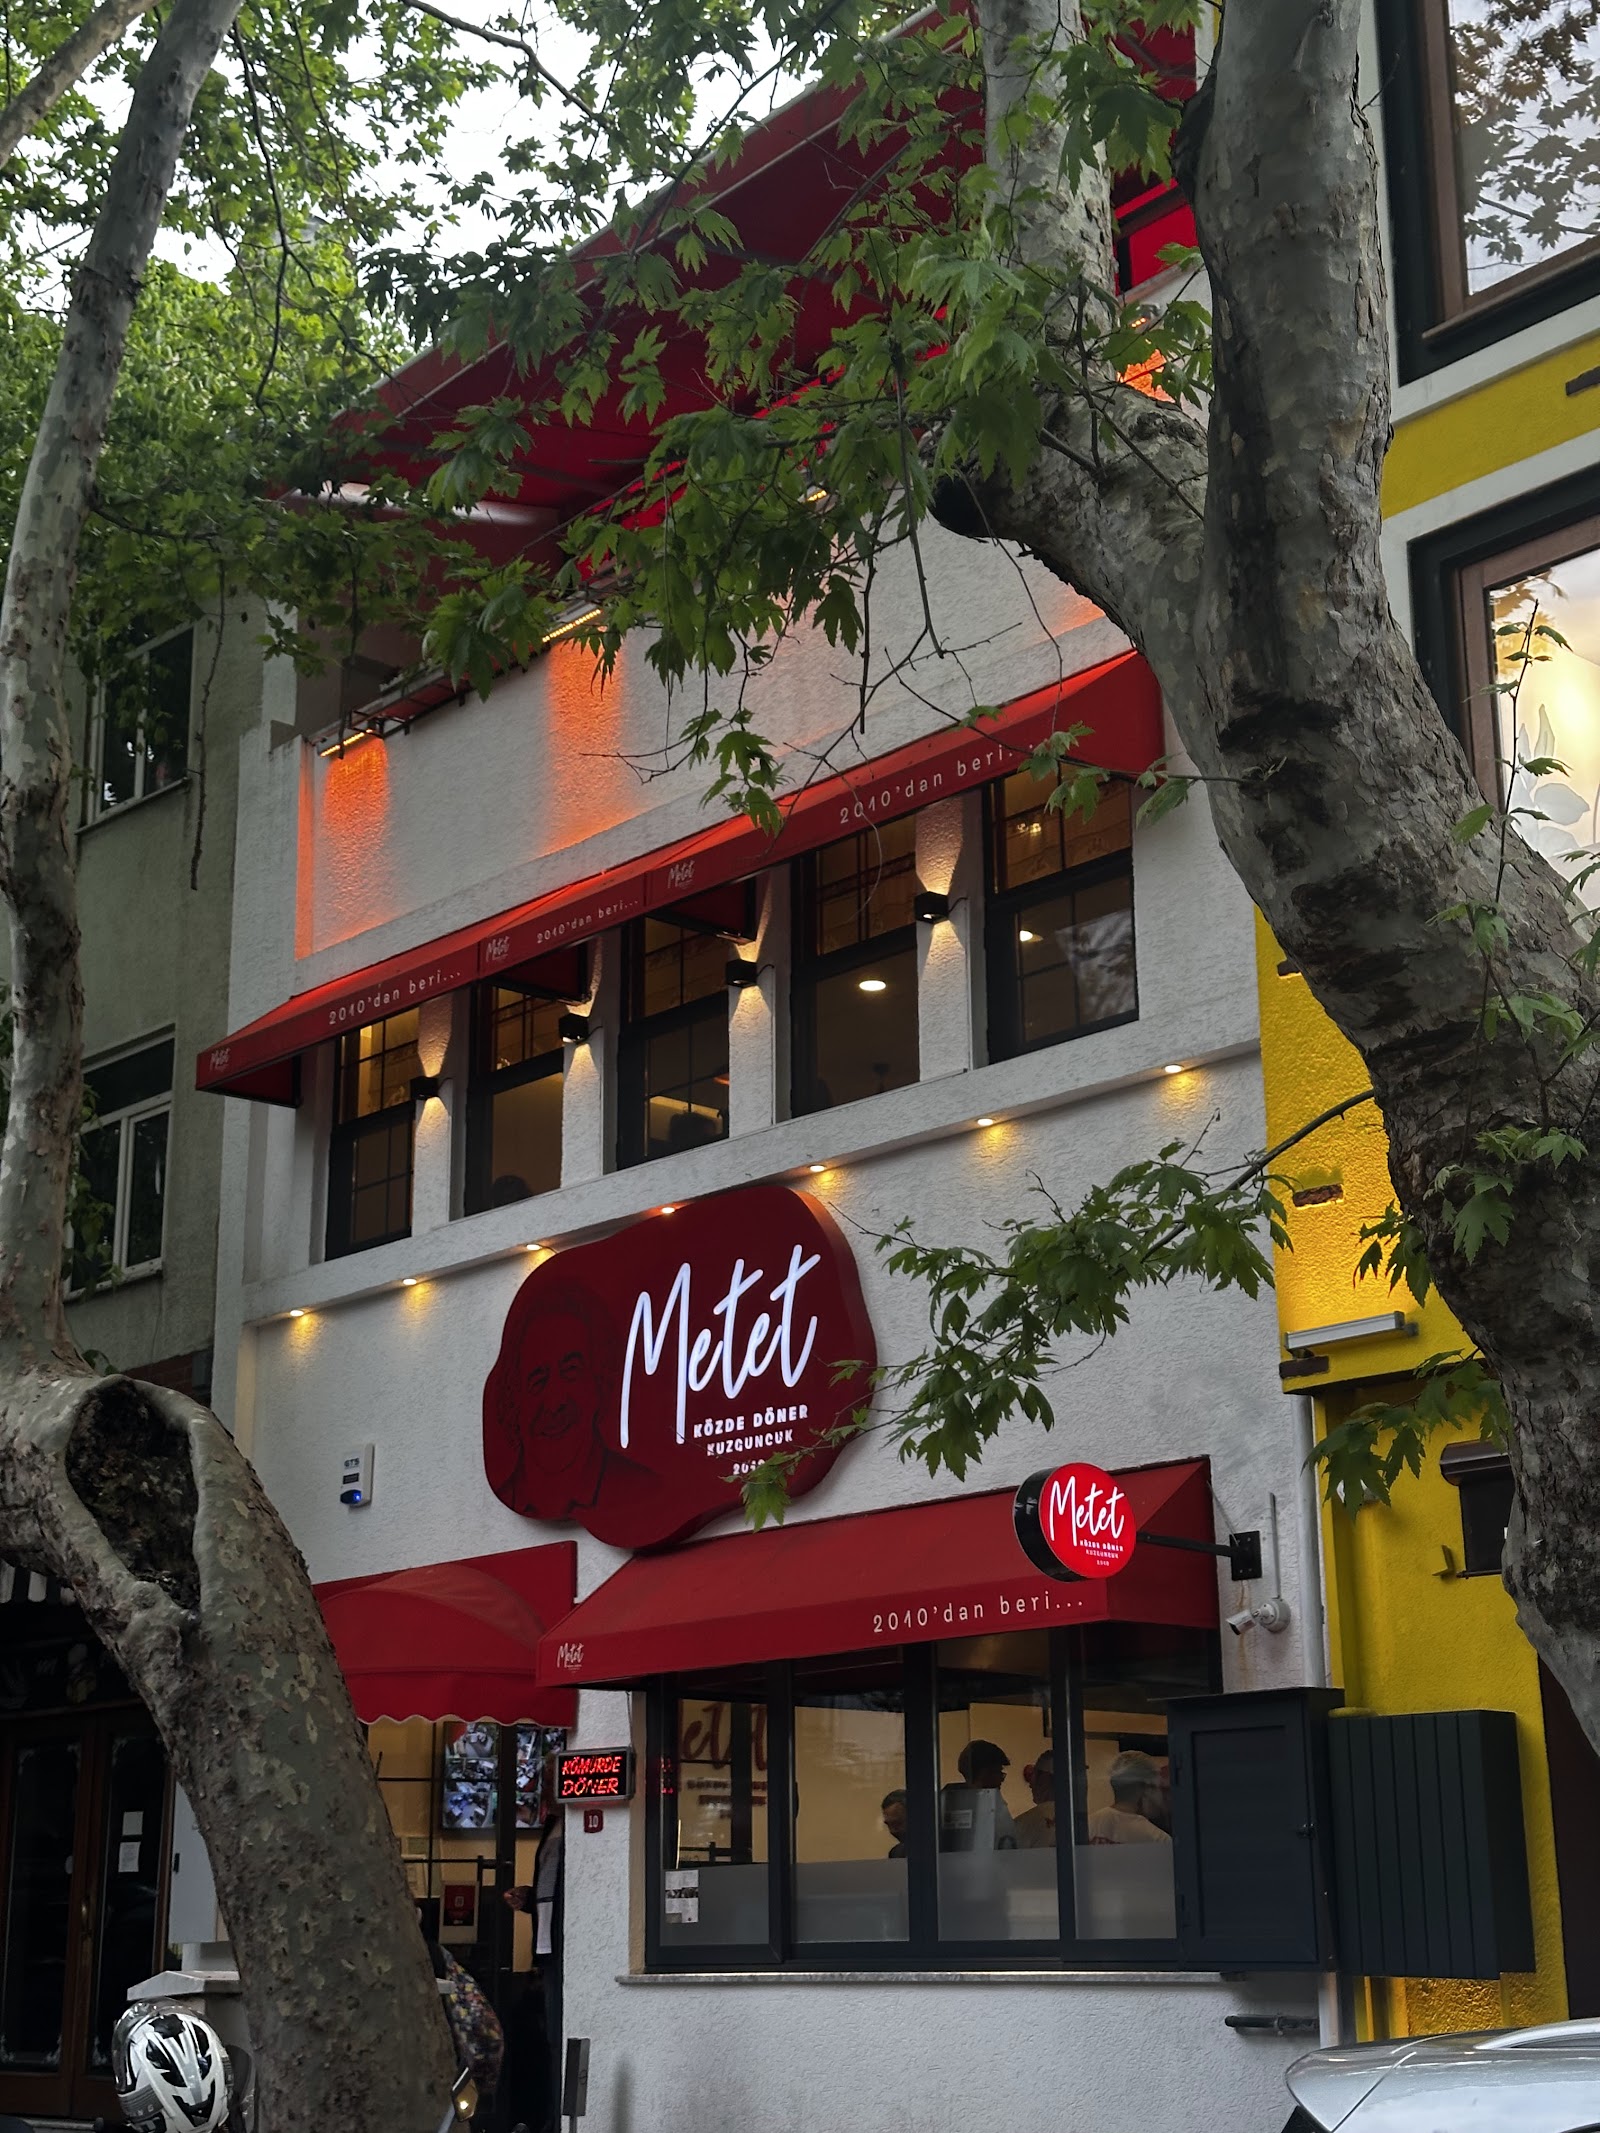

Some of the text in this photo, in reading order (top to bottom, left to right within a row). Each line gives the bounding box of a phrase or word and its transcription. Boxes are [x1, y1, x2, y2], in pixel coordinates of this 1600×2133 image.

[409, 969, 461, 994] beri...
[620, 1244, 821, 1449] Metet
[693, 1404, 808, 1439] KÖZDE DÖNER
[1049, 1476, 1125, 1547] Metet
[873, 1591, 1083, 1633] 2010'dan beri...
[562, 1777, 619, 1796] DÖNER
[588, 1815, 599, 1828] 10
